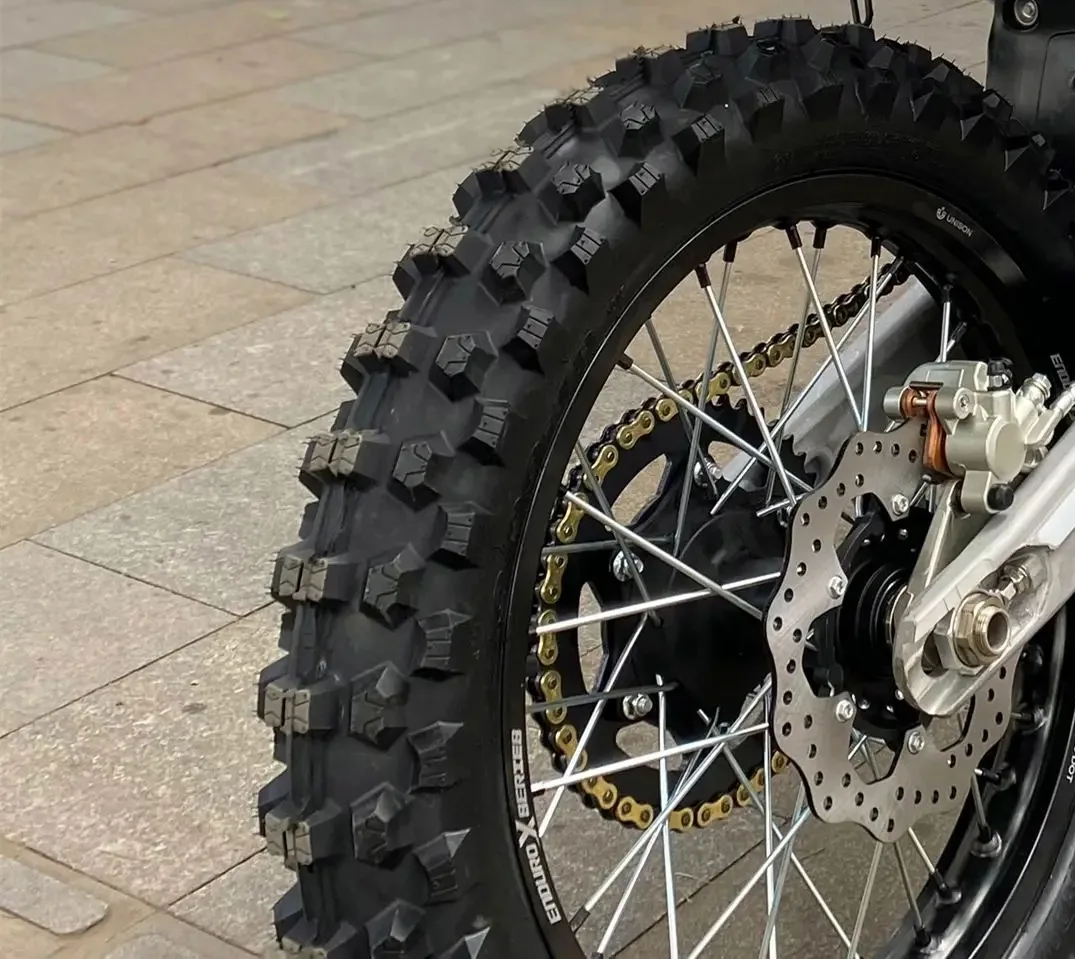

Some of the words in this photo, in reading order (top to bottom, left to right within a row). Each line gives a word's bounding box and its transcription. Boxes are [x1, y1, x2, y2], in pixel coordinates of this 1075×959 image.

[947, 213, 974, 237] UNISON
[511, 728, 530, 818] SERIES
[525, 842, 562, 925] ENDURO
